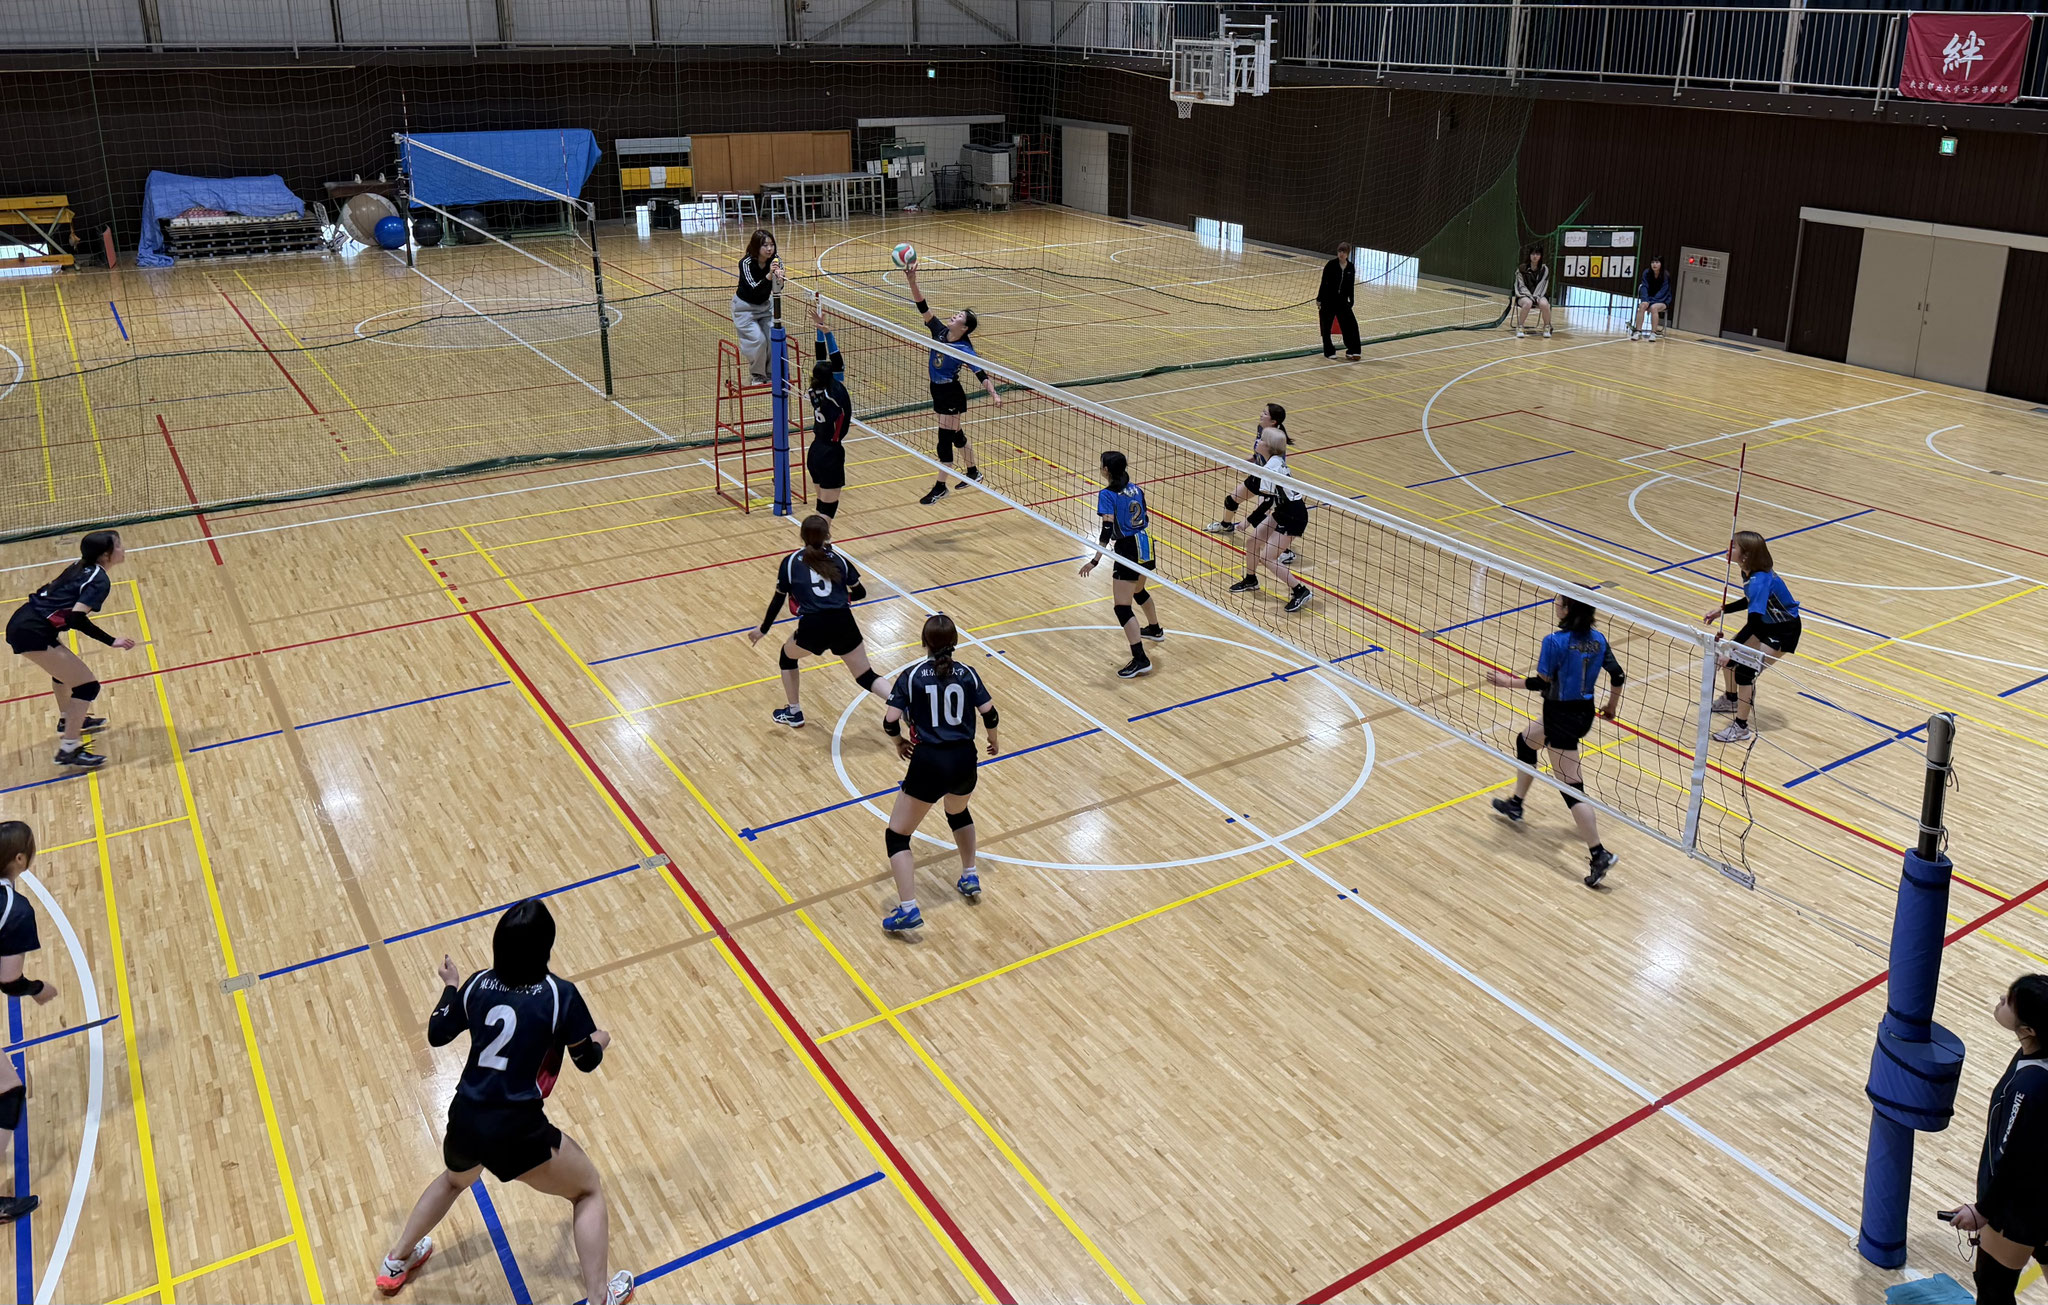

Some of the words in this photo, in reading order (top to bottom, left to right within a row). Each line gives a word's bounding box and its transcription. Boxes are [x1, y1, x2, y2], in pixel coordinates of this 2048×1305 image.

[1942, 30, 1986, 81] 絆
[1591, 264, 1600, 276] 0
[1128, 500, 1145, 527] 2
[809, 567, 832, 597] 5
[925, 683, 965, 728] 10
[477, 1004, 517, 1071] 2
